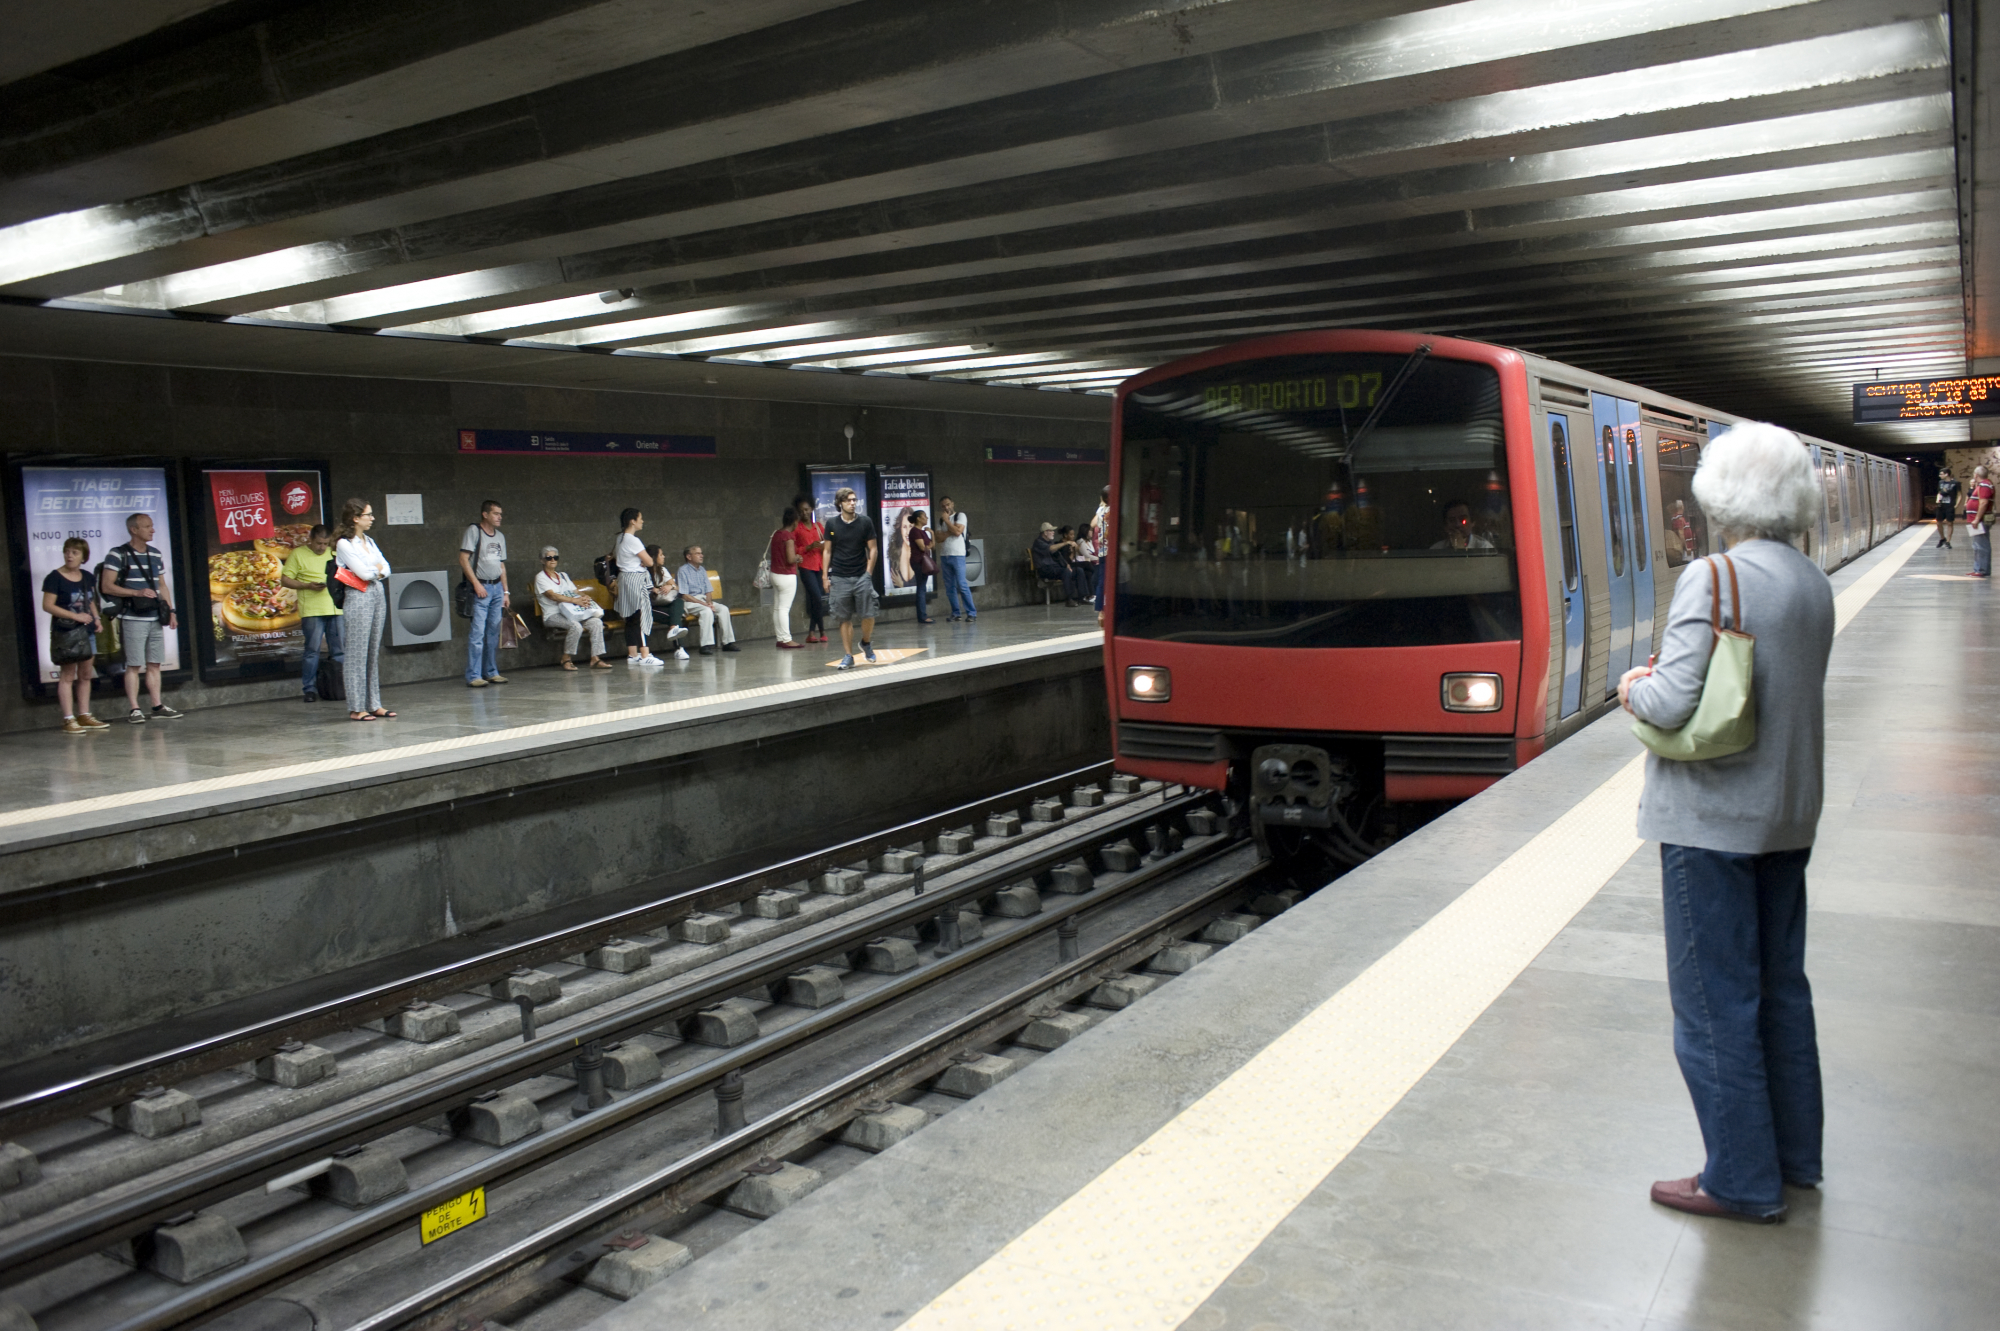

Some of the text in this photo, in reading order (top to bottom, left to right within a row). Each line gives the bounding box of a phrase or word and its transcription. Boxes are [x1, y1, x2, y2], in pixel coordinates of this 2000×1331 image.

[1205, 372, 1382, 412] AEROPORTO 07
[1866, 377, 2000, 397] SENTIDO AEROPORTO
[1900, 402, 1973, 418] AEROPORTO
[635, 440, 659, 450] Oriente
[71, 478, 122, 492] TIAGO
[218, 489, 234, 497] MENU
[40, 495, 155, 510] BETTENCOURT
[33, 529, 102, 540] NOVO DISCO
[426, 1196, 462, 1219] PERIGO
[438, 1211, 451, 1224] DE
[428, 1216, 462, 1239] MORTE
